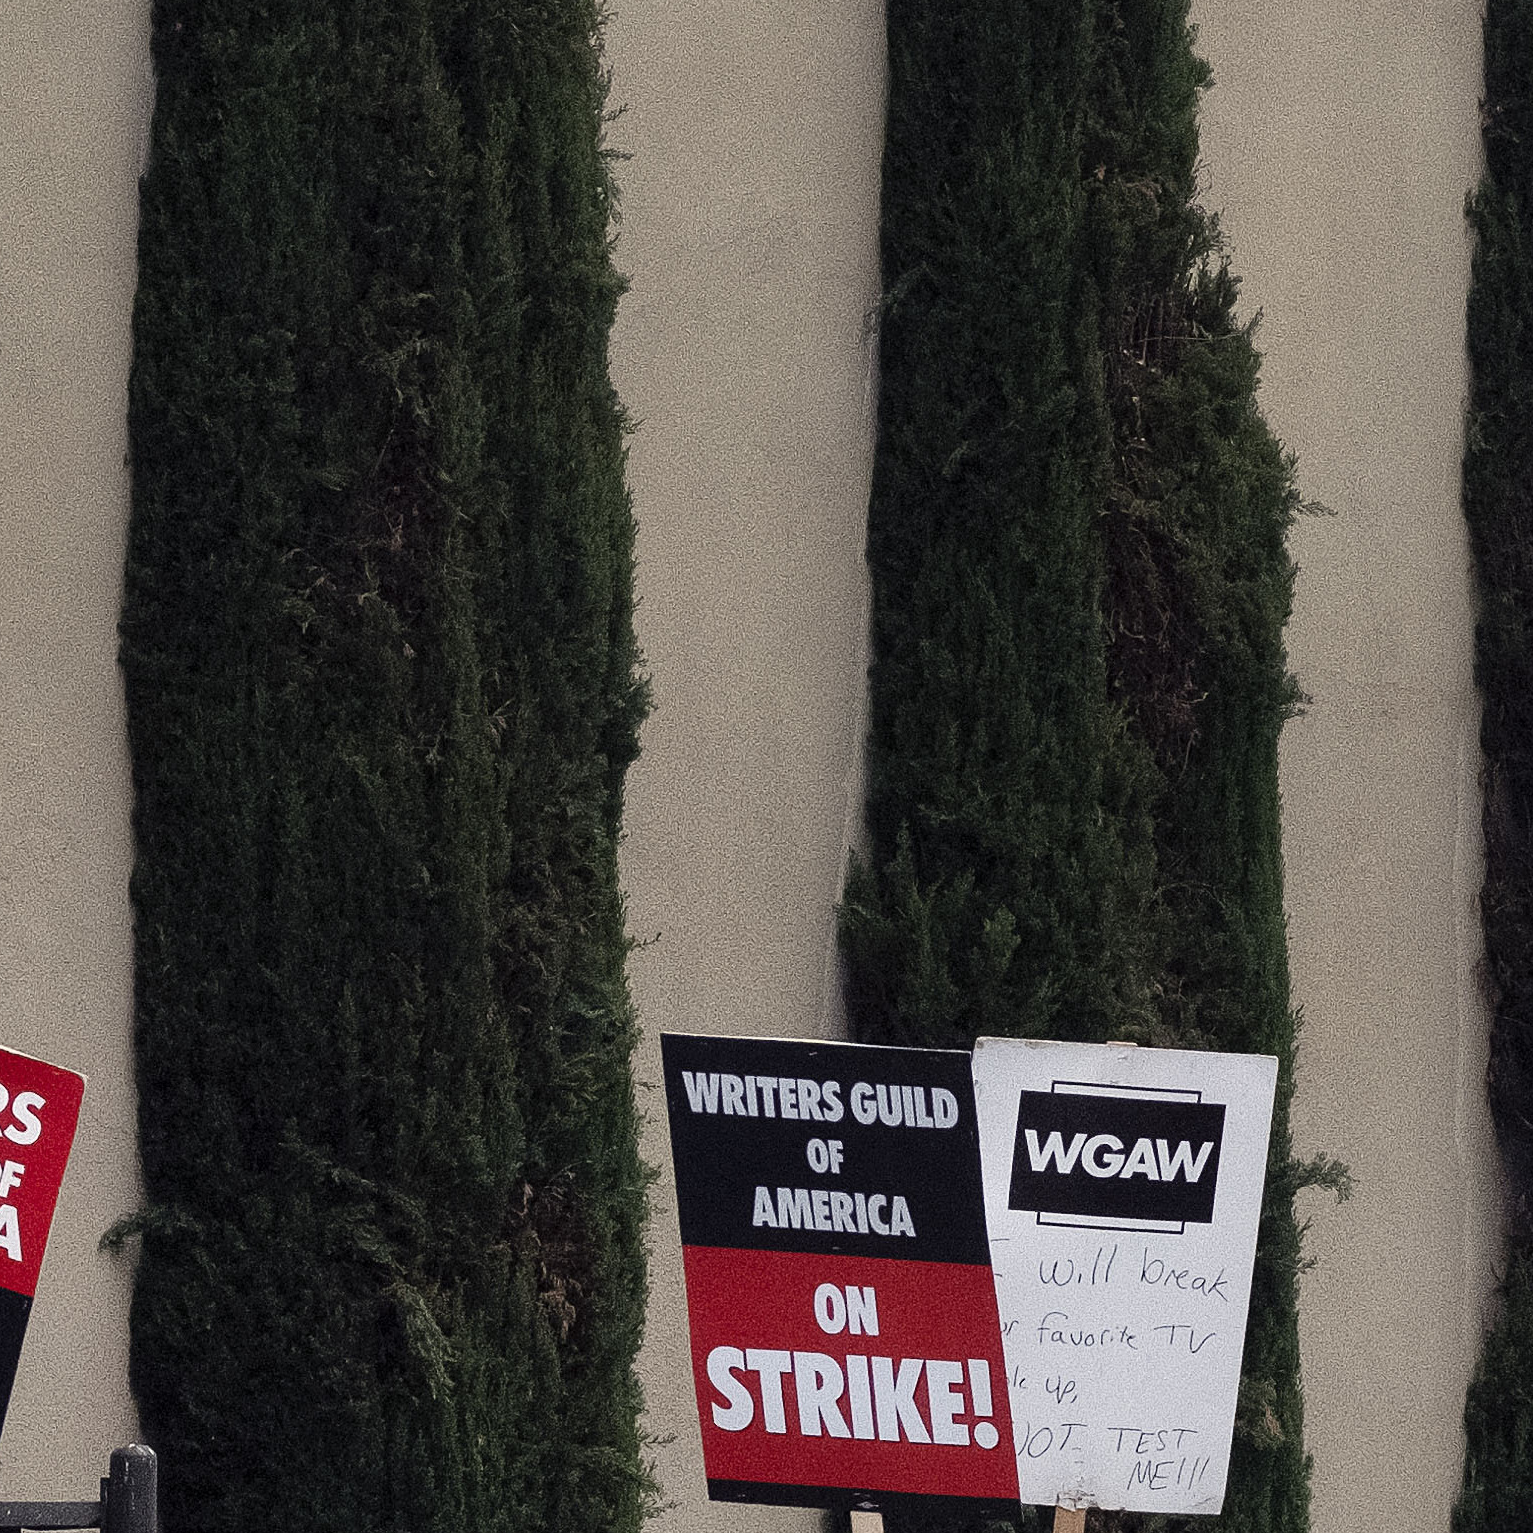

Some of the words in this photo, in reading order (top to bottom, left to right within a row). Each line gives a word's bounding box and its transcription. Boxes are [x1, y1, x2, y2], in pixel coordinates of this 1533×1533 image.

[682, 1071, 843, 1122] WRITERS
[851, 1082, 959, 1129] GUILD
[808, 1138, 844, 1174] OF
[1024, 1128, 1214, 1184] WGAW
[752, 1186, 916, 1237] AMERICA
[1039, 1244, 1118, 1287] will
[1141, 1246, 1229, 1302] break
[814, 1283, 879, 1336] ON
[1037, 1312, 1138, 1350] favorite
[1153, 1325, 1216, 1354] TV
[706, 1346, 1000, 1451] STRIKE!
[1046, 1376, 1078, 1404] up,
[1107, 1427, 1198, 1454] TEST
